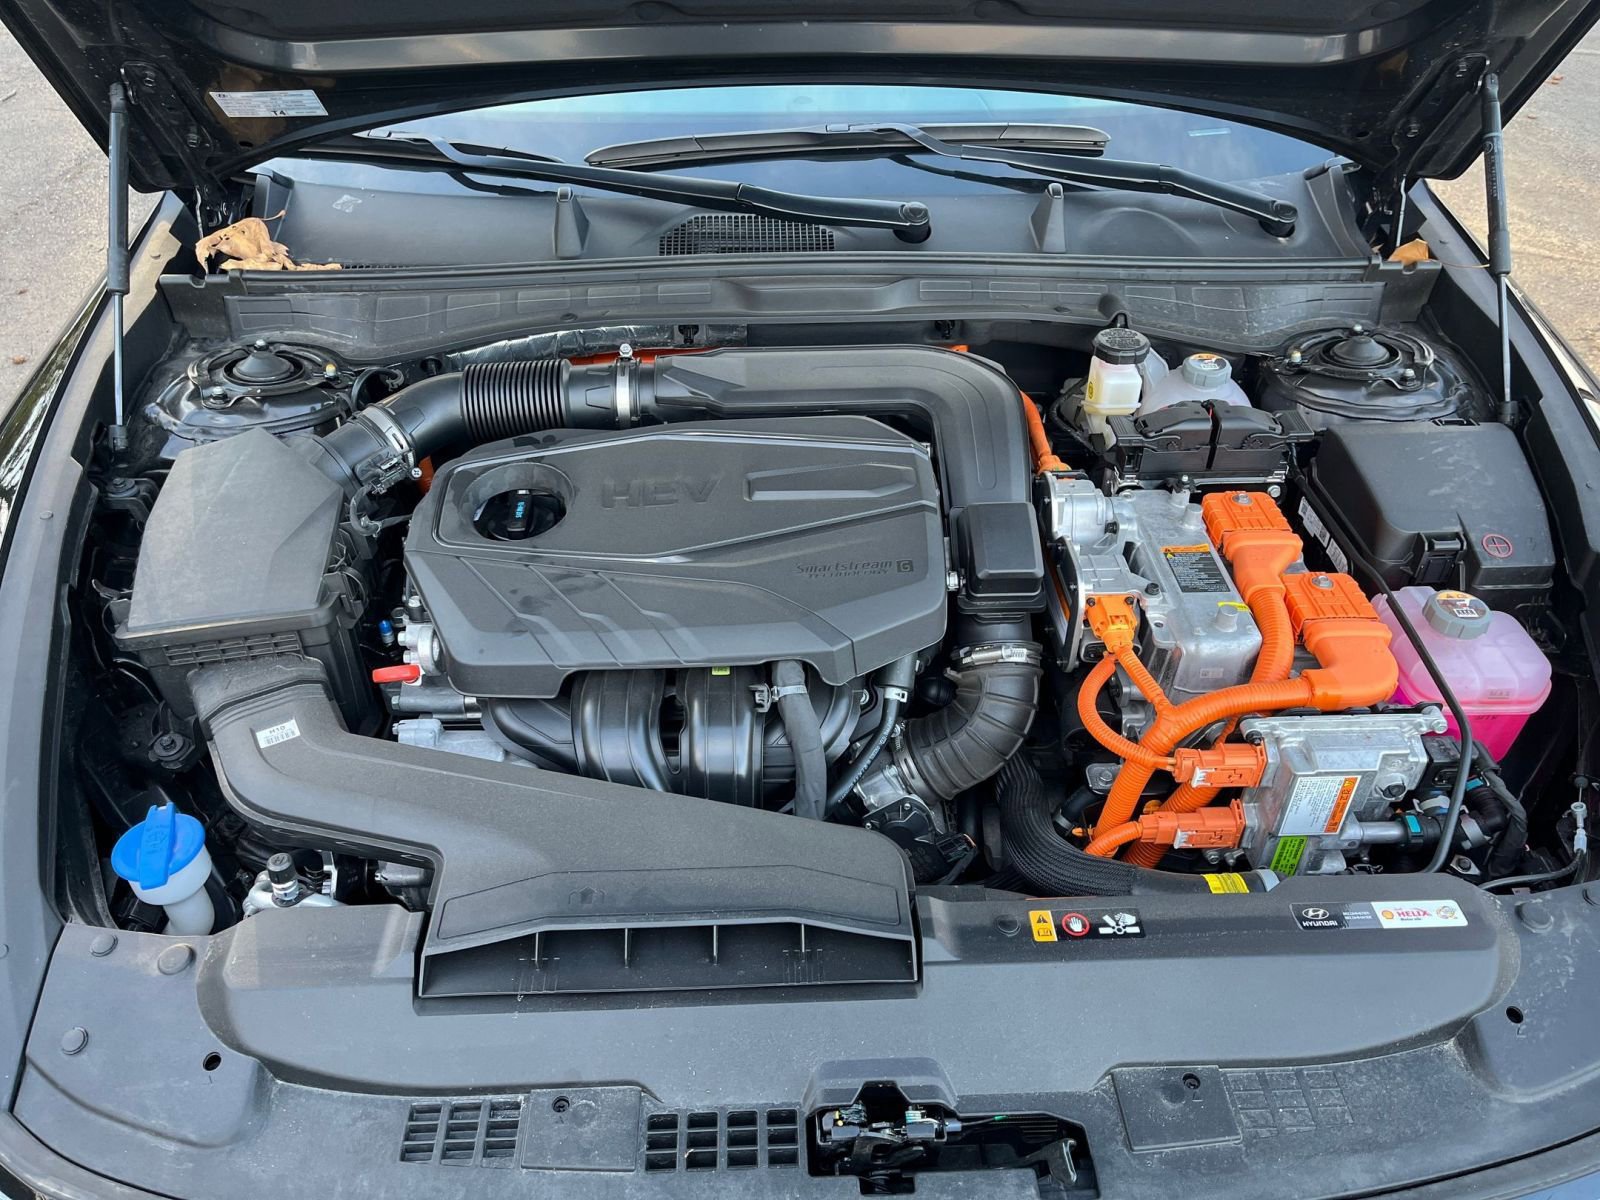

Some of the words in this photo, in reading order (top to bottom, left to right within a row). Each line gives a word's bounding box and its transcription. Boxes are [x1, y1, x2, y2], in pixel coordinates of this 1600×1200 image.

[601, 479, 720, 509] HEV
[797, 560, 892, 573] Smartstream
[1396, 910, 1429, 918] HELIX
